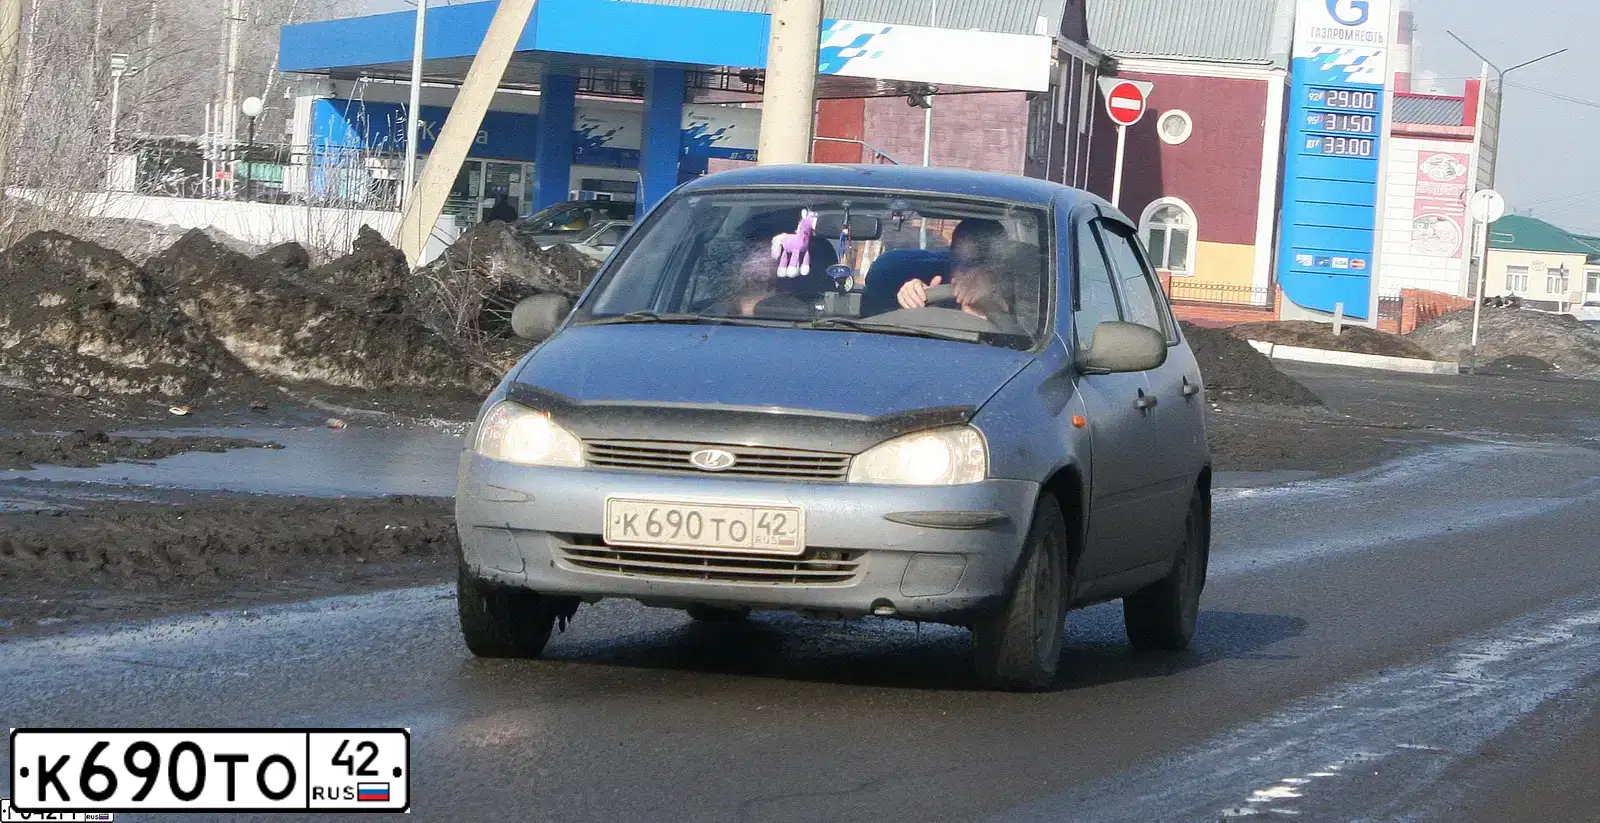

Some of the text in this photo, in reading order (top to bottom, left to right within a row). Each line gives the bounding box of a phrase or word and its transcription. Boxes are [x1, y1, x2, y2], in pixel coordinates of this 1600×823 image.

[1310, 27, 1383, 43] ГАЗПРОМНЕФТЬ
[1327, 90, 1374, 109] 29.00
[1326, 113, 1372, 132] 31.50
[1325, 137, 1370, 155] 33.00
[623, 508, 787, 542] К690ТО 42
[754, 535, 777, 546] RUS
